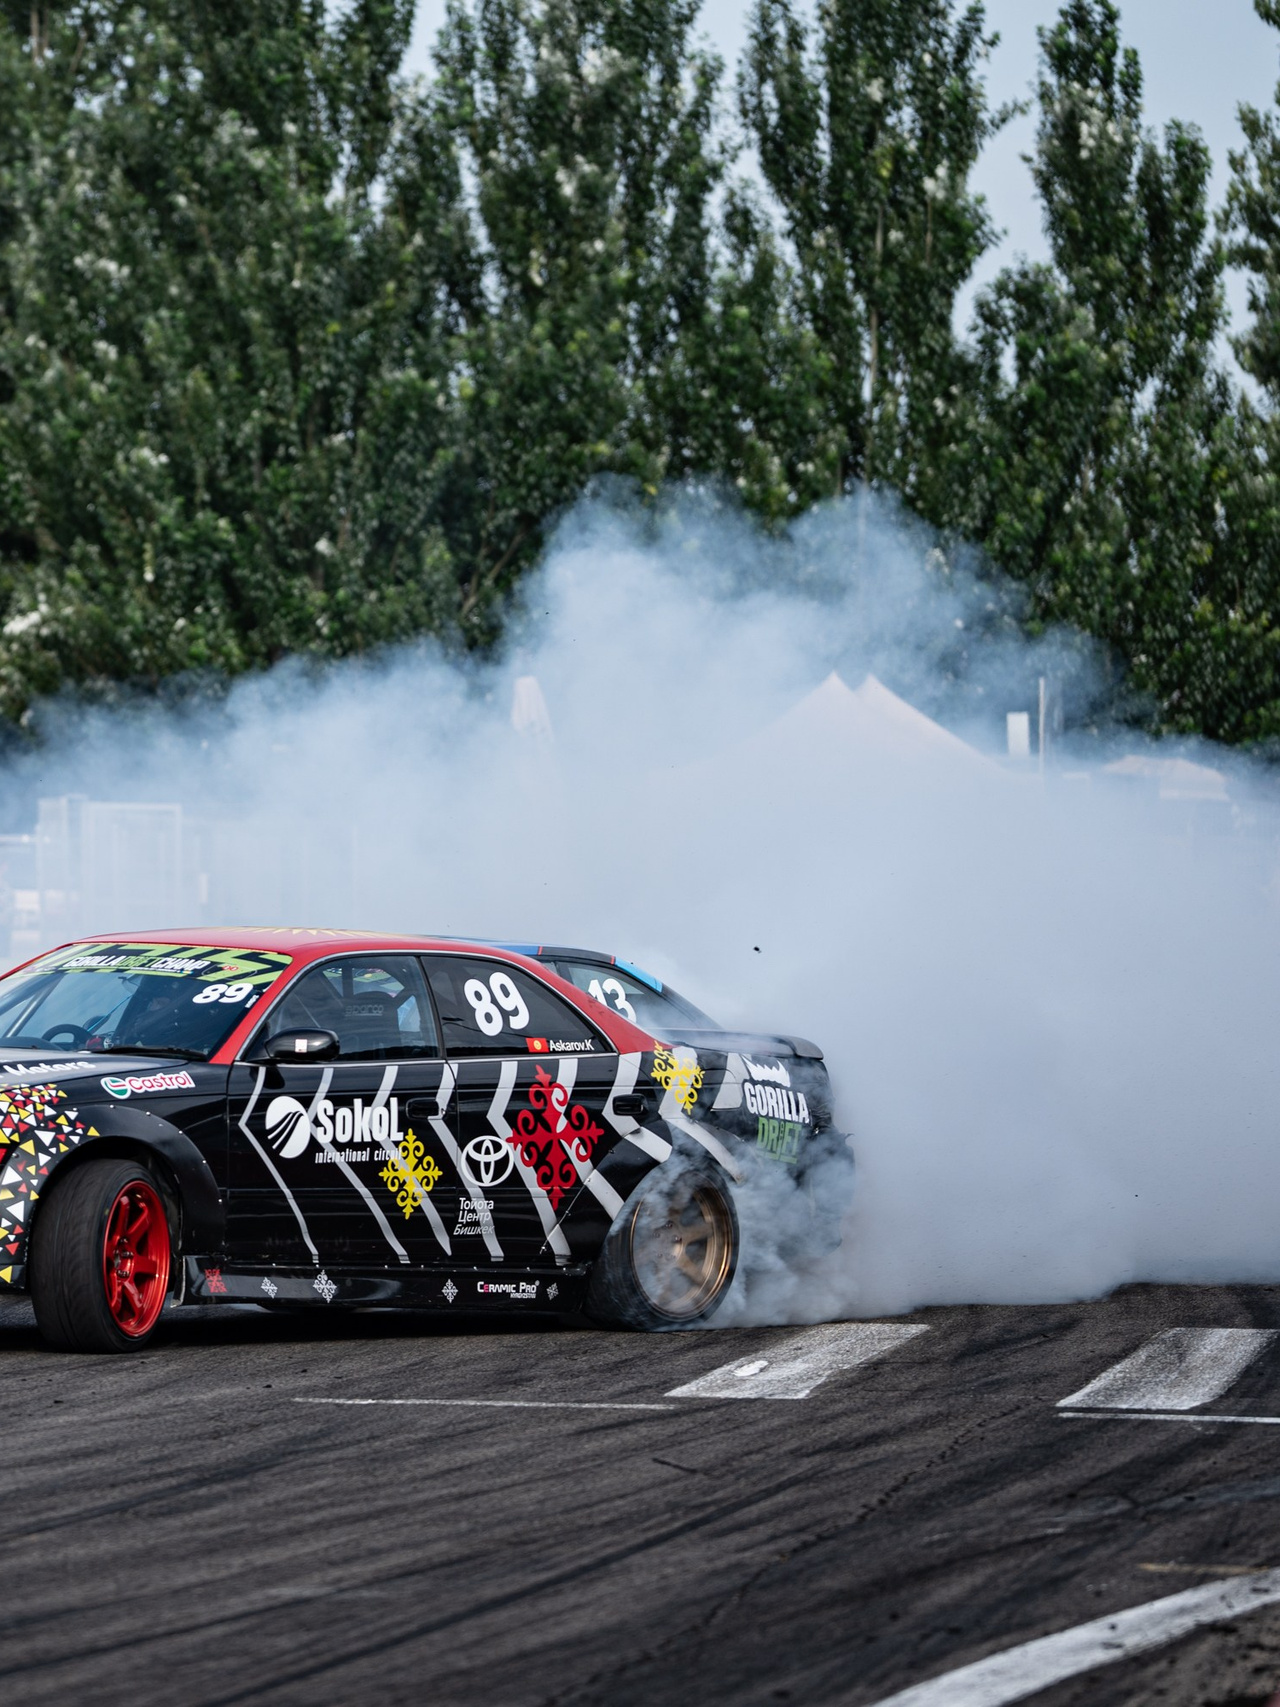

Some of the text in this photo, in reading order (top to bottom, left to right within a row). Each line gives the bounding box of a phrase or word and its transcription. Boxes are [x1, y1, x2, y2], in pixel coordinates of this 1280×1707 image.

[192, 982, 254, 1004] 89
[587, 978, 637, 1024] 13
[464, 971, 530, 1037] 89
[549, 1039, 595, 1052] Askarov.K
[3, 1060, 97, 1077] Motors
[128, 1072, 193, 1091] Castrol
[743, 1081, 810, 1124] GORILLA
[756, 1116, 803, 1160] DRIFT
[314, 1148, 370, 1164] international
[459, 1197, 494, 1210] Тойота
[457, 1210, 491, 1225] Центр
[453, 1224, 496, 1235] Бишкек
